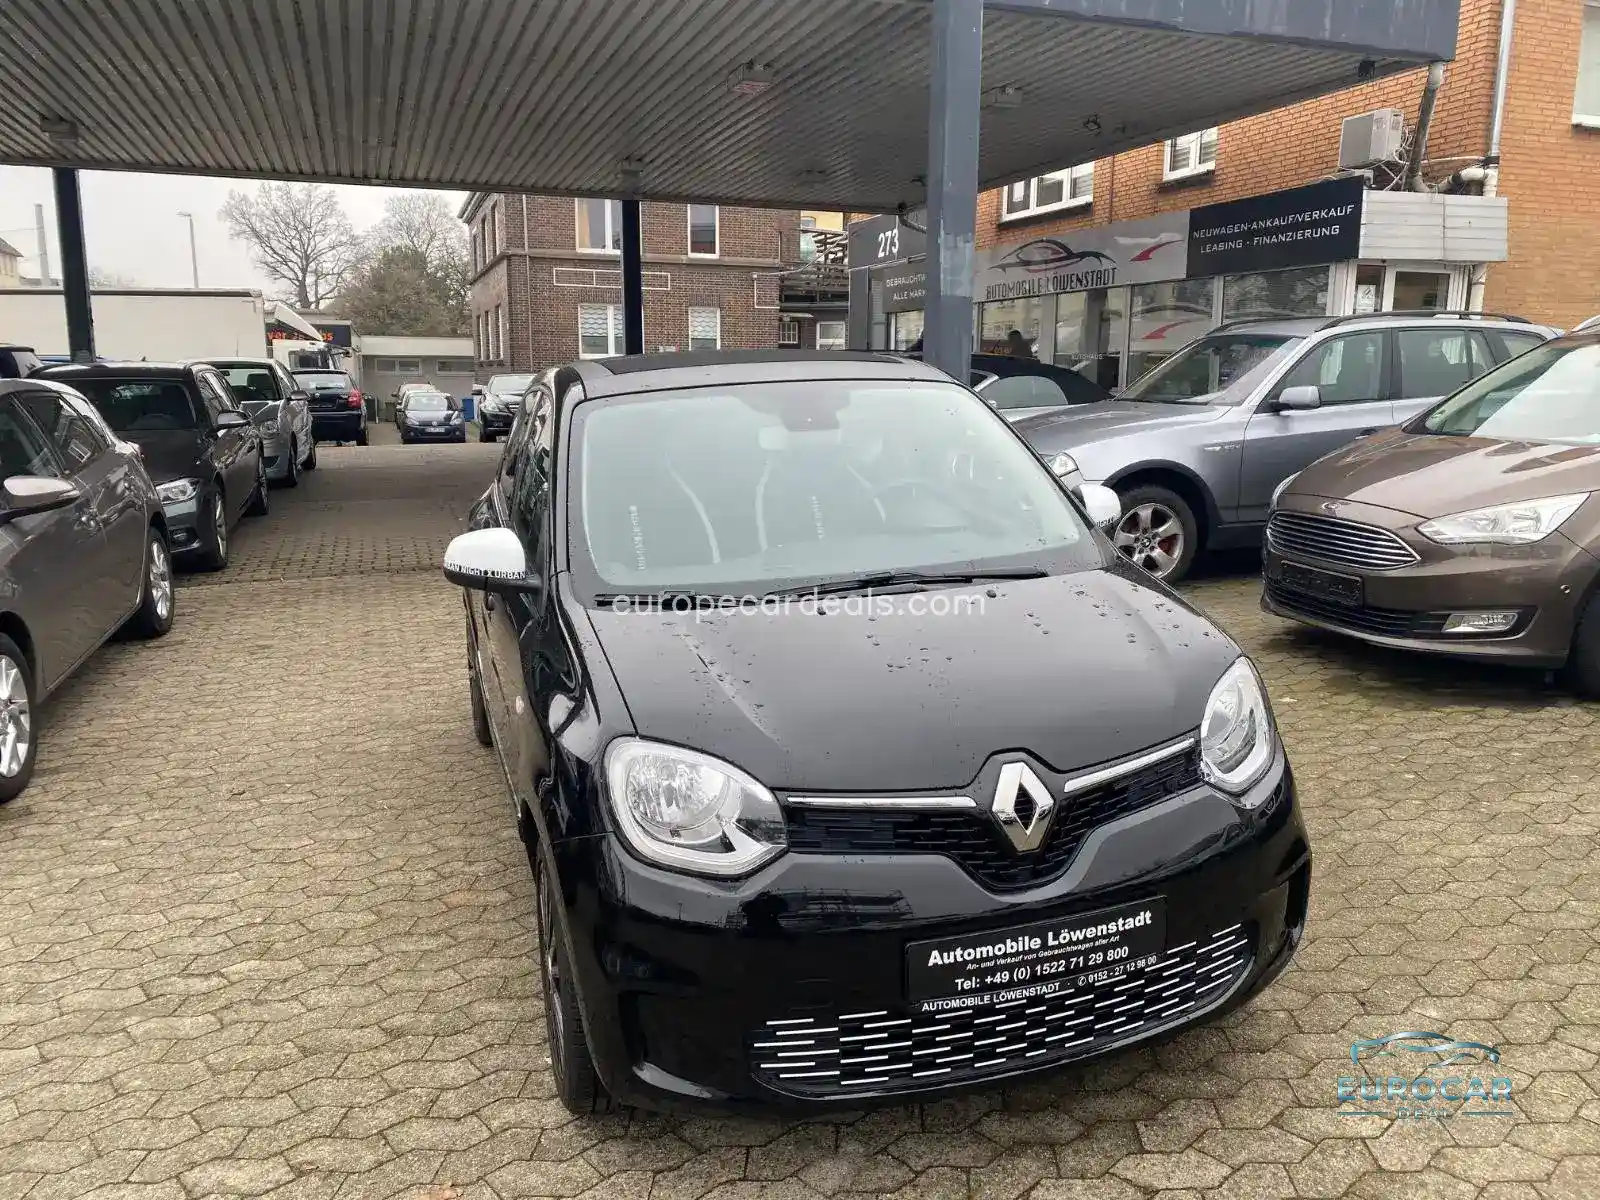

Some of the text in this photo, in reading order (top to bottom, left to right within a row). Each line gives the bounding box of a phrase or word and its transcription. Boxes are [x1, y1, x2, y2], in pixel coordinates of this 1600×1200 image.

[1193, 204, 1354, 239] NEUWAGEN-ANKAUF/VERKAUF
[878, 228, 899, 258] 273
[1200, 225, 1340, 253] LEASING FINANZIERUNG
[892, 291, 908, 301] ALLE
[986, 267, 1117, 299] AUTOMOBILE LÖWENSTADT
[461, 564, 485, 576] NIGHT
[495, 569, 526, 580] URBAN
[927, 910, 1152, 967] Automobile Löwenstadt
[966, 935, 1120, 971] An- und Verkauf von Gebrauchtwagen aller Art
[921, 995, 991, 1012] AUTOMOBILE
[993, 982, 1060, 1003] LÖWENSTADT
[1088, 970, 1108, 983] 0152
[1114, 966, 1124, 975] 27
[1126, 962, 1136, 972] 12
[1136, 959, 1146, 969] 98
[1147, 955, 1157, 965] 00
[955, 946, 1129, 991] Tel: +49 (0) 1522 71 29 800
